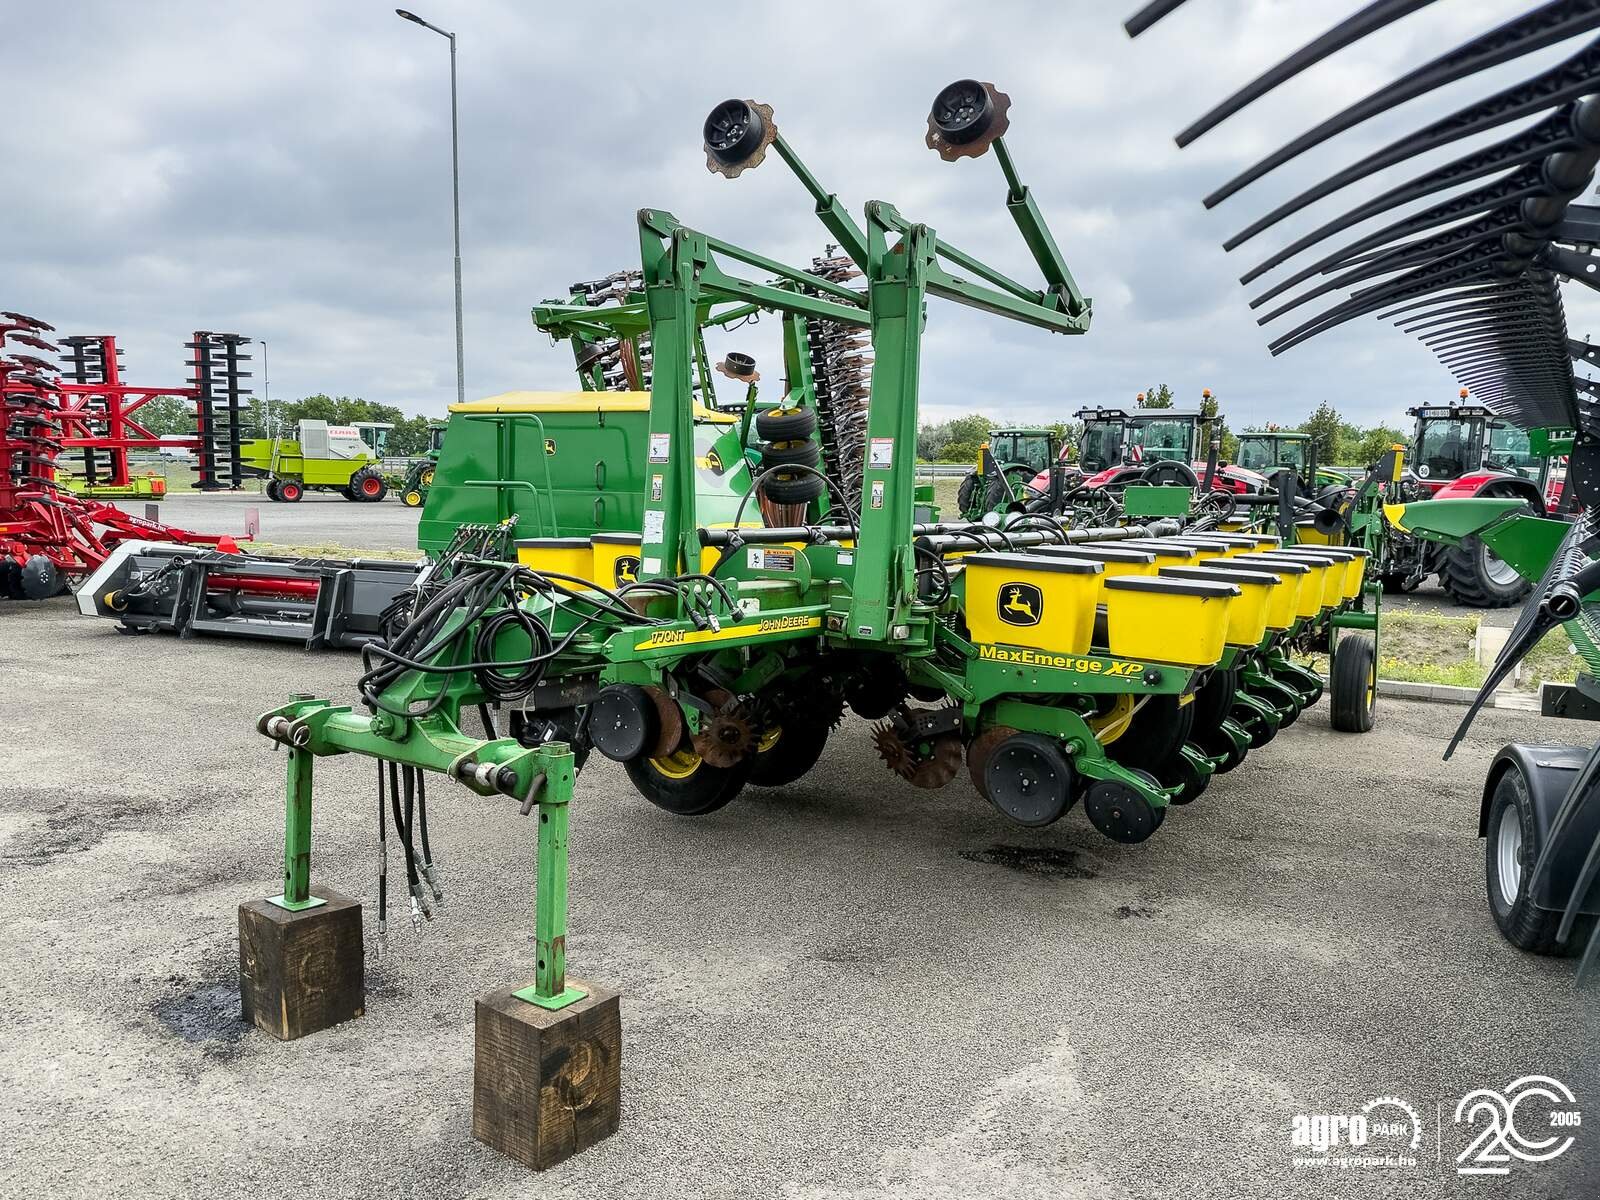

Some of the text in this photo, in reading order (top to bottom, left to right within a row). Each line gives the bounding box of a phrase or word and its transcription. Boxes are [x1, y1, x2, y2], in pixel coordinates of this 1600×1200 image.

[128, 516, 167, 532] agropark.hu
[979, 644, 1144, 676] MaxEmerge XP
